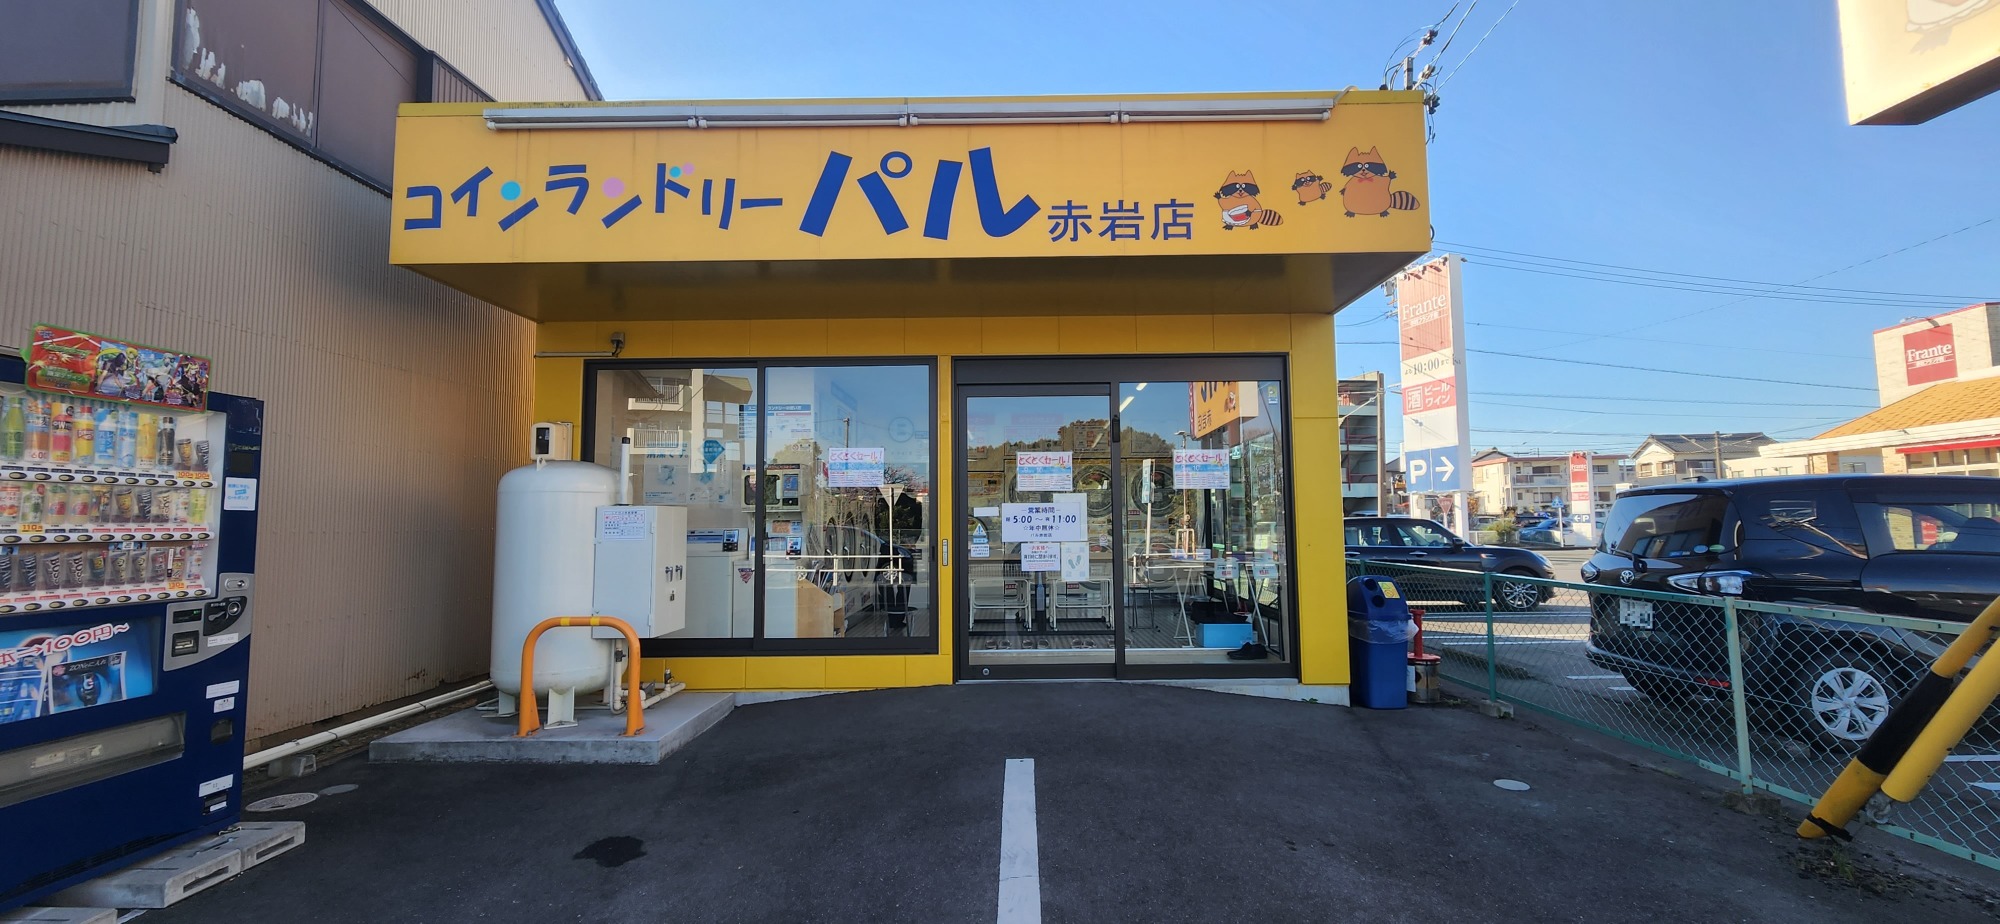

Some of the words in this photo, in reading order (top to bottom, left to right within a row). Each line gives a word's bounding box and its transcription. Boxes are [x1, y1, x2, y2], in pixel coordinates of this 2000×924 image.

[404, 162, 784, 232] コインランドリー
[799, 146, 1041, 241] パル
[1047, 199, 1195, 242] 赤岩店
[1402, 294, 1446, 320] Frante
[1907, 343, 1952, 362] Frante
[1424, 383, 1451, 396] ビール
[1408, 391, 1423, 409] 酒
[1425, 396, 1451, 408] ワイン
[1409, 459, 1427, 485] P
[1013, 515, 1033, 524] 5:00
[1052, 515, 1077, 524] 11:00
